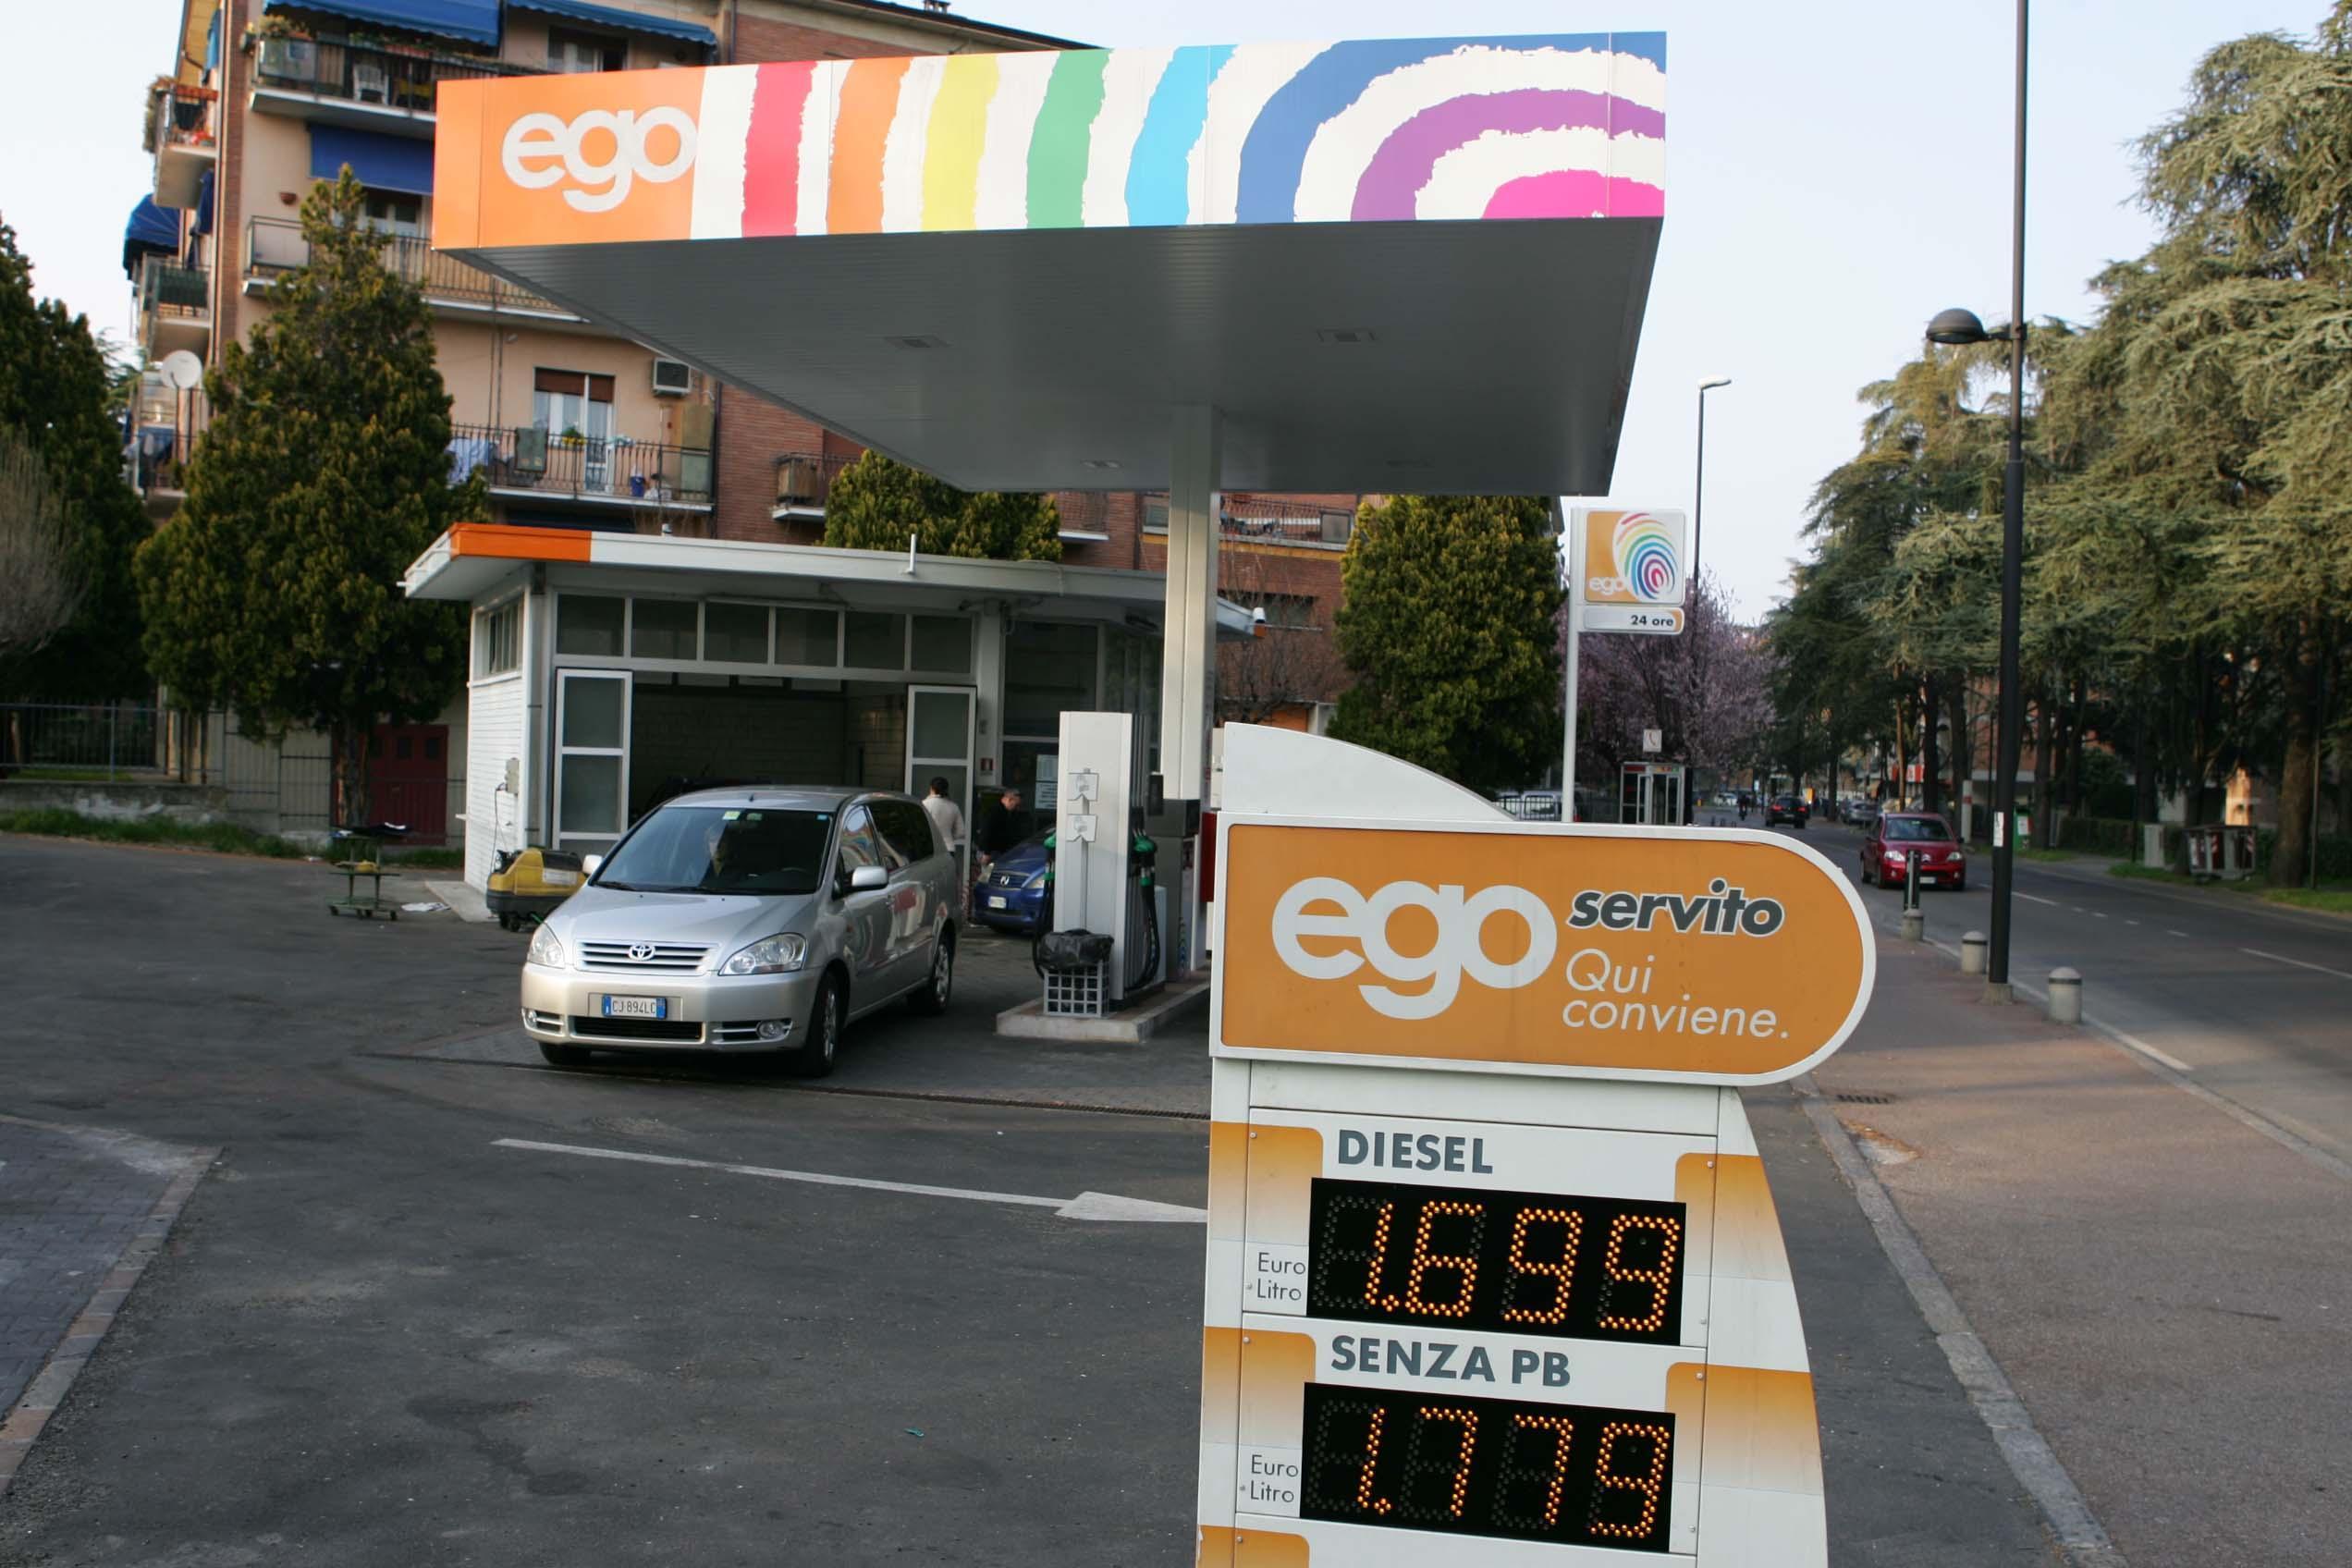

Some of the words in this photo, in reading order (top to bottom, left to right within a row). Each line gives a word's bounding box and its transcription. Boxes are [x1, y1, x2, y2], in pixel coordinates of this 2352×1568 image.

[502, 105, 698, 214] ego
[1588, 575, 1627, 595] ego
[1630, 615, 1648, 625] 24
[1651, 617, 1674, 627] ore
[1566, 878, 1784, 938] servito
[1272, 876, 1558, 1021] ego
[1564, 948, 1655, 996] Qui
[1562, 994, 1789, 1039] conviene.
[1338, 1129, 1493, 1175] DIESEL
[1257, 1252, 1306, 1275] Euro
[1364, 1199, 1682, 1332] 1.699
[1256, 1278, 1302, 1301] Litro
[1331, 1334, 1496, 1383] SENZA
[1511, 1349, 1571, 1388] PB
[1251, 1453, 1299, 1477] Euro
[1356, 1406, 1670, 1539] 1.779
[1250, 1479, 1294, 1502] Litro
